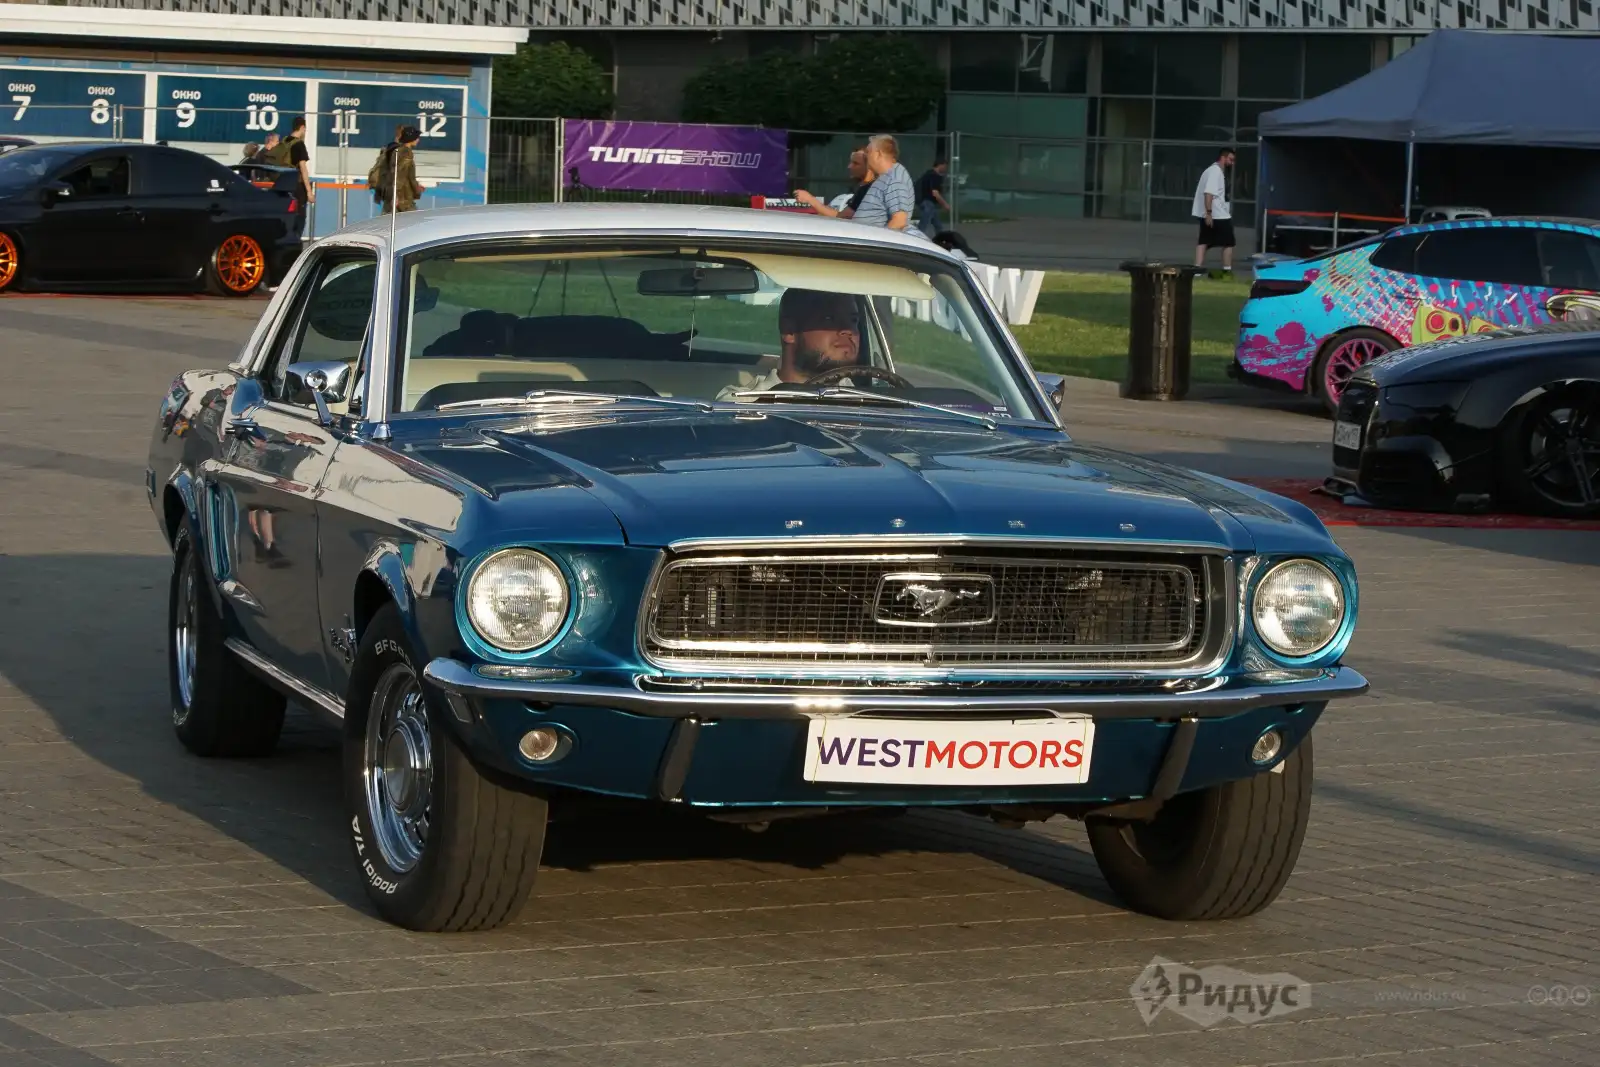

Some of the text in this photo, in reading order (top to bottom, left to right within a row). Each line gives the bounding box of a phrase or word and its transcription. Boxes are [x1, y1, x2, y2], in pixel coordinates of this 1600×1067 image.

[8, 83, 36, 93] ОКНО
[87, 86, 115, 96] ОКНО
[172, 90, 201, 101] ОКНО
[248, 93, 277, 103] ОКНО
[333, 97, 360, 107] ОКНО
[418, 100, 445, 110] ОКНО
[12, 95, 31, 121] 7
[90, 98, 110, 124] 8
[176, 102, 196, 128] 9
[245, 104, 279, 131] 10
[331, 108, 360, 134] 11
[416, 112, 447, 137] 12
